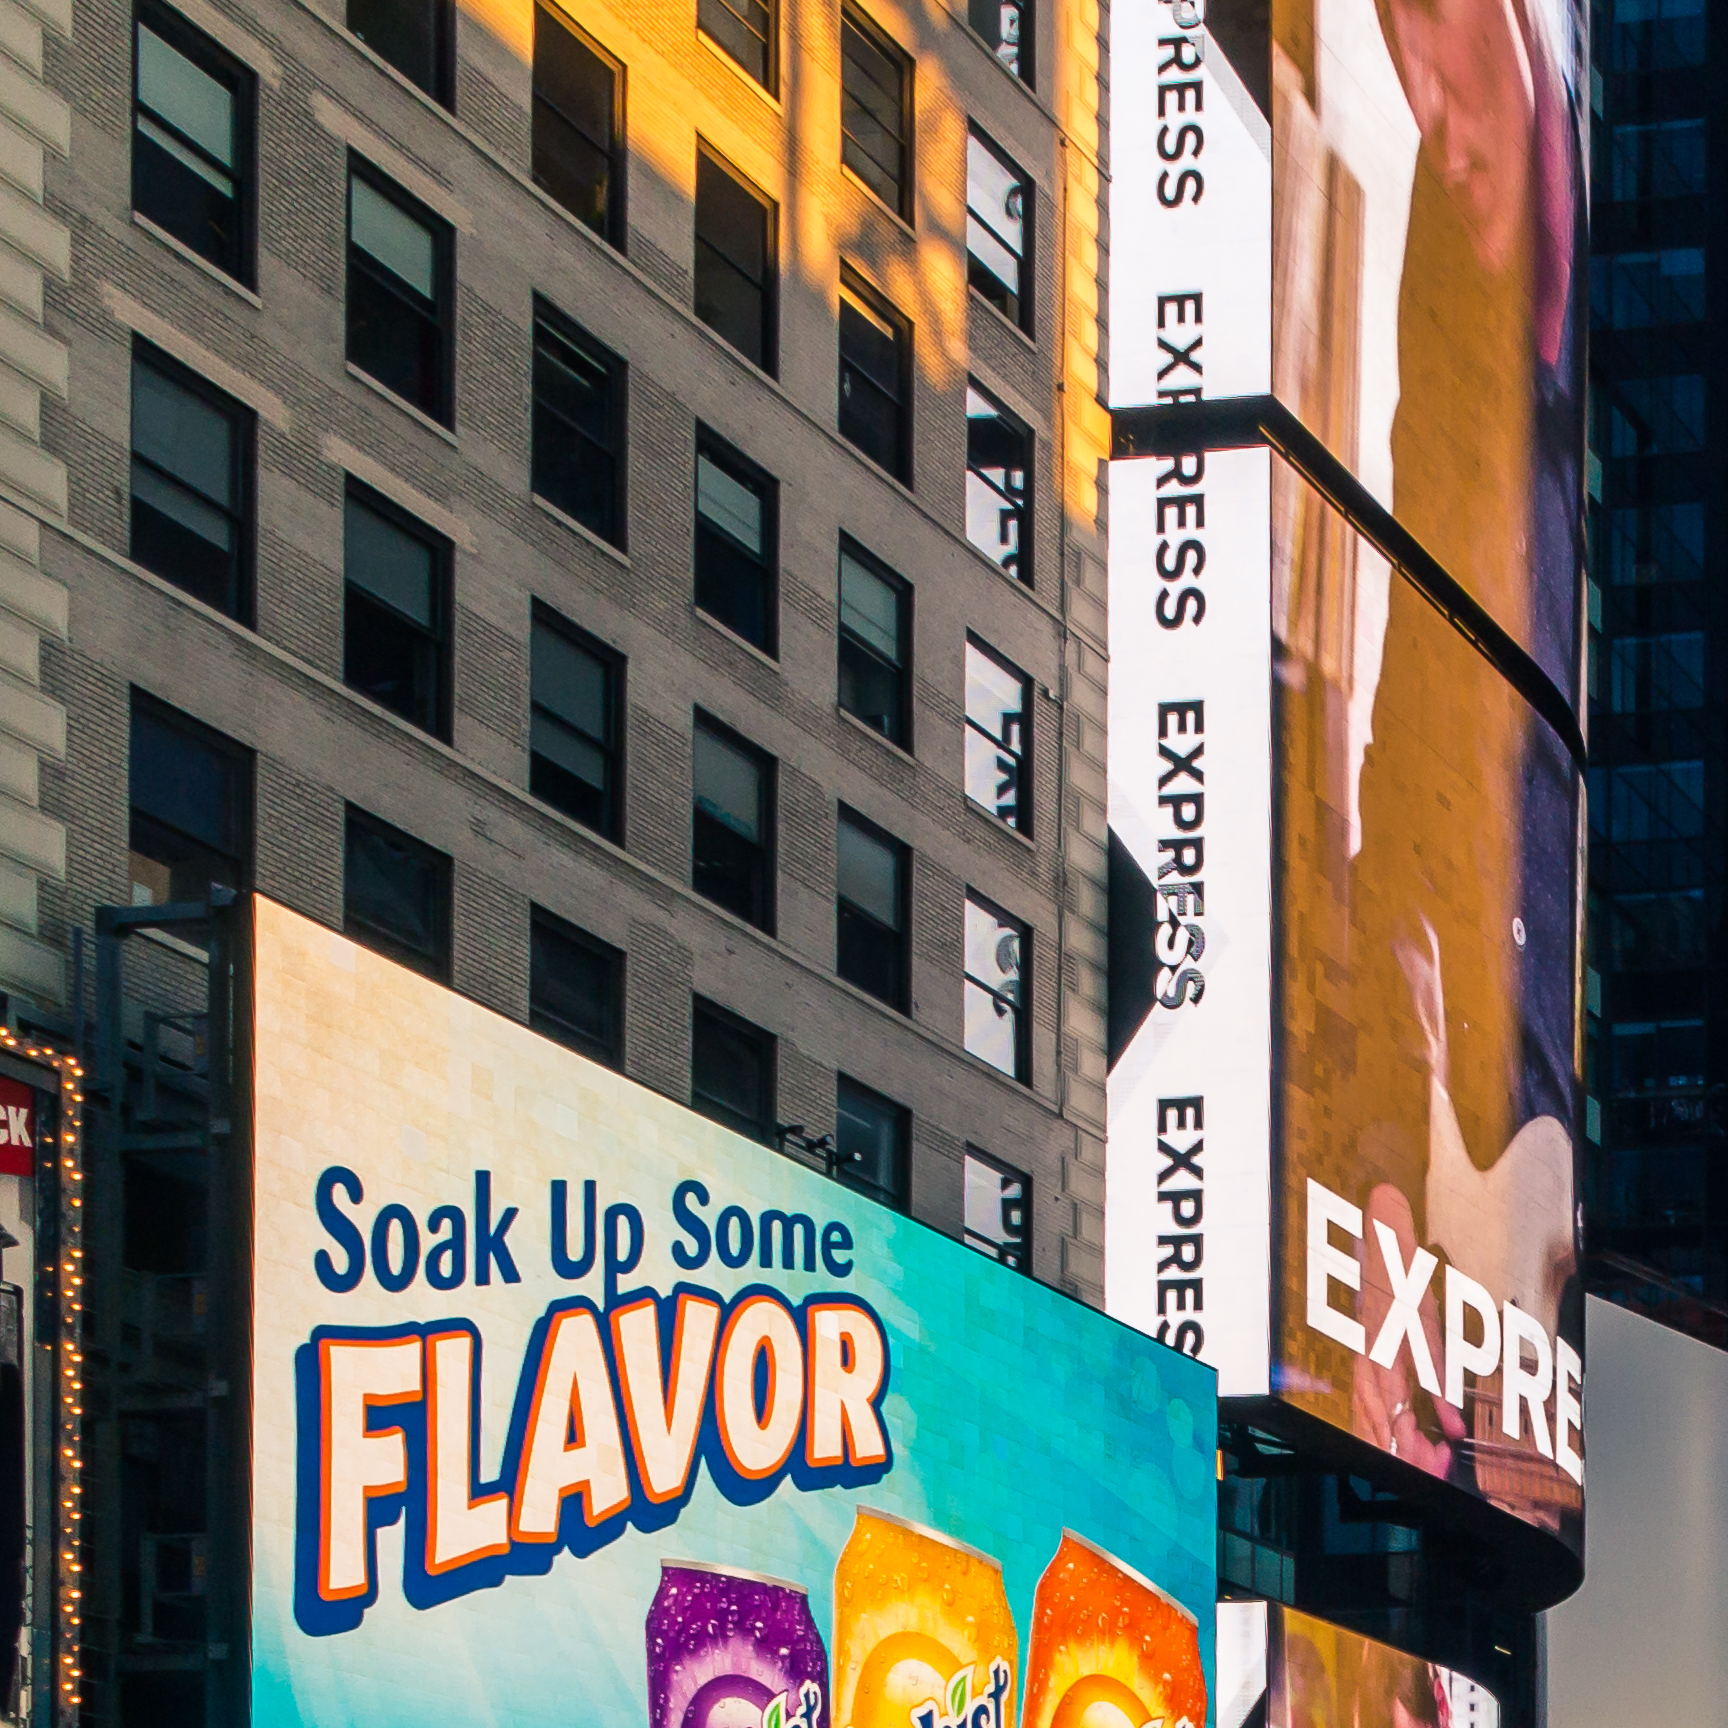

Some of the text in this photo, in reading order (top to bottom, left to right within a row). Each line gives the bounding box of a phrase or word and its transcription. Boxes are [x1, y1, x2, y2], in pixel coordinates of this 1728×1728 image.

[1156, 292, 1206, 630] EXRESS
[1156, 699, 1206, 1011] EXPRESS
[314, 1166, 855, 1295] Soak Up Some
[1305, 1177, 1585, 1487] EXPRE
[296, 1284, 893, 1634] FLAVOR
